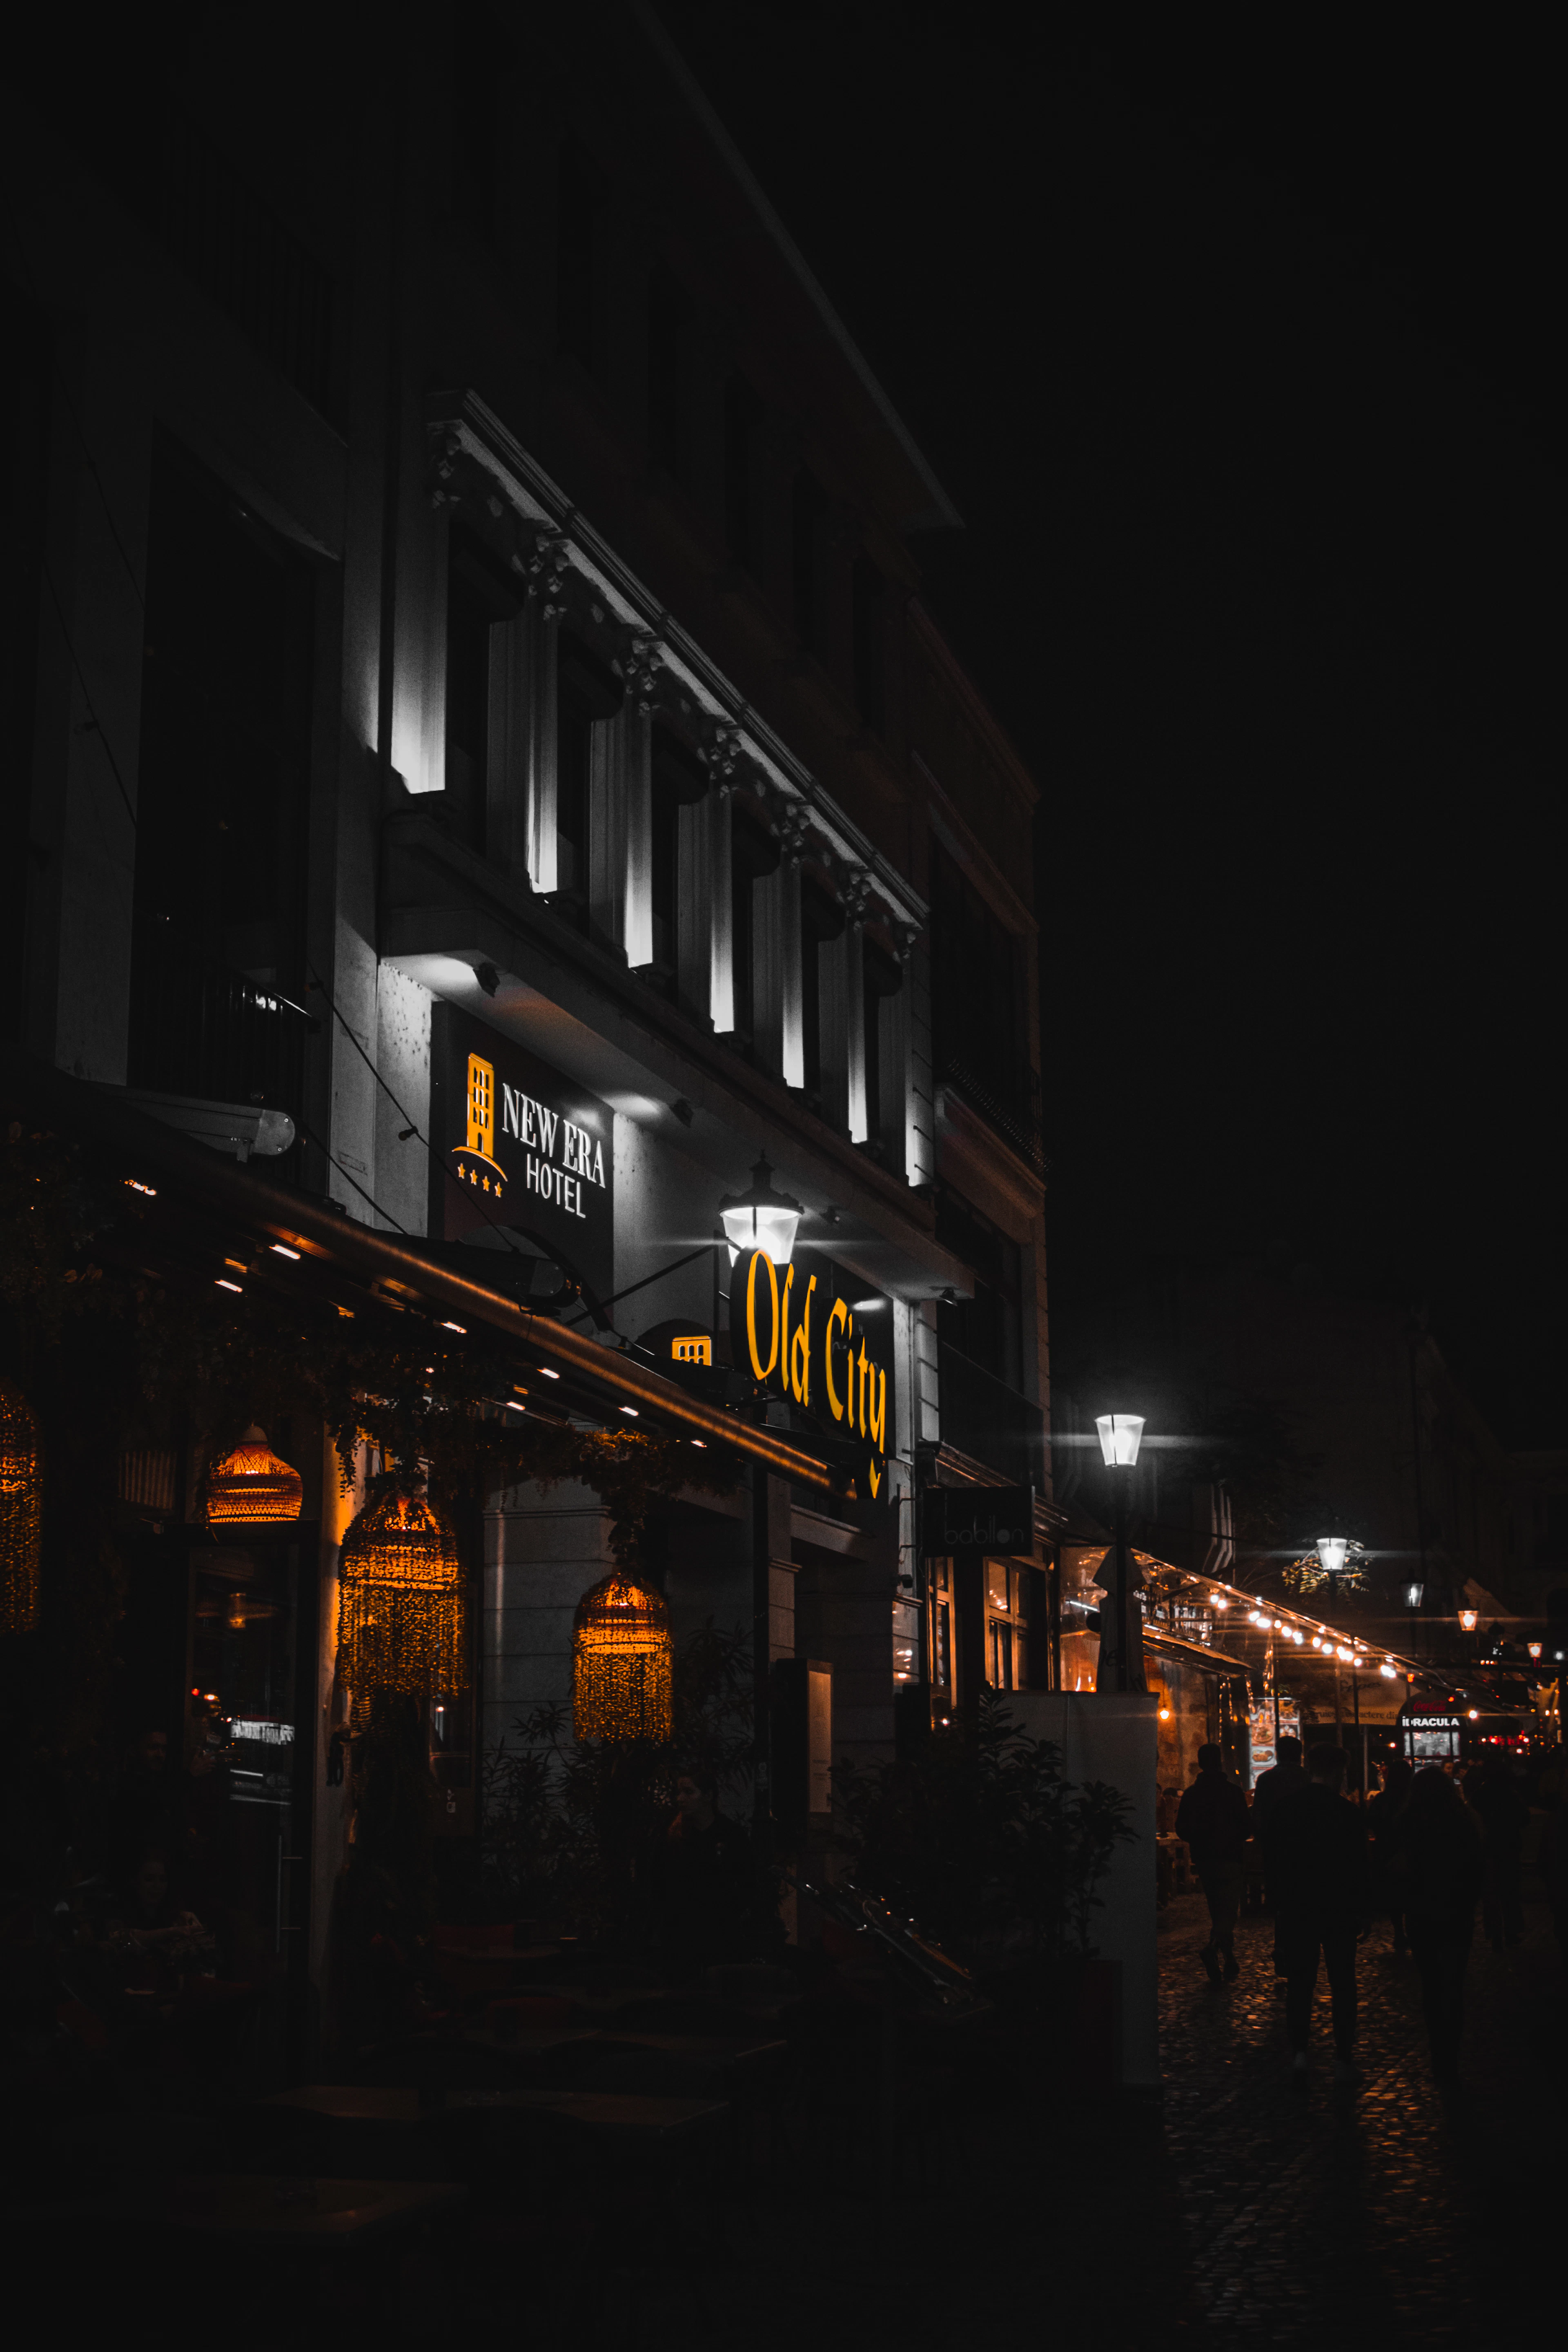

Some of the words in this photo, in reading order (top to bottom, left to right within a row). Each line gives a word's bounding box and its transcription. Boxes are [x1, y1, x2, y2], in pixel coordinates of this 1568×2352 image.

[502, 1083, 559, 1157] NEW
[563, 1119, 606, 1188] ERA
[527, 1154, 586, 1218] HOTEL
[747, 1249, 817, 1407] Old
[826, 1298, 886, 1499] City
[944, 1492, 1025, 1545] babilon
